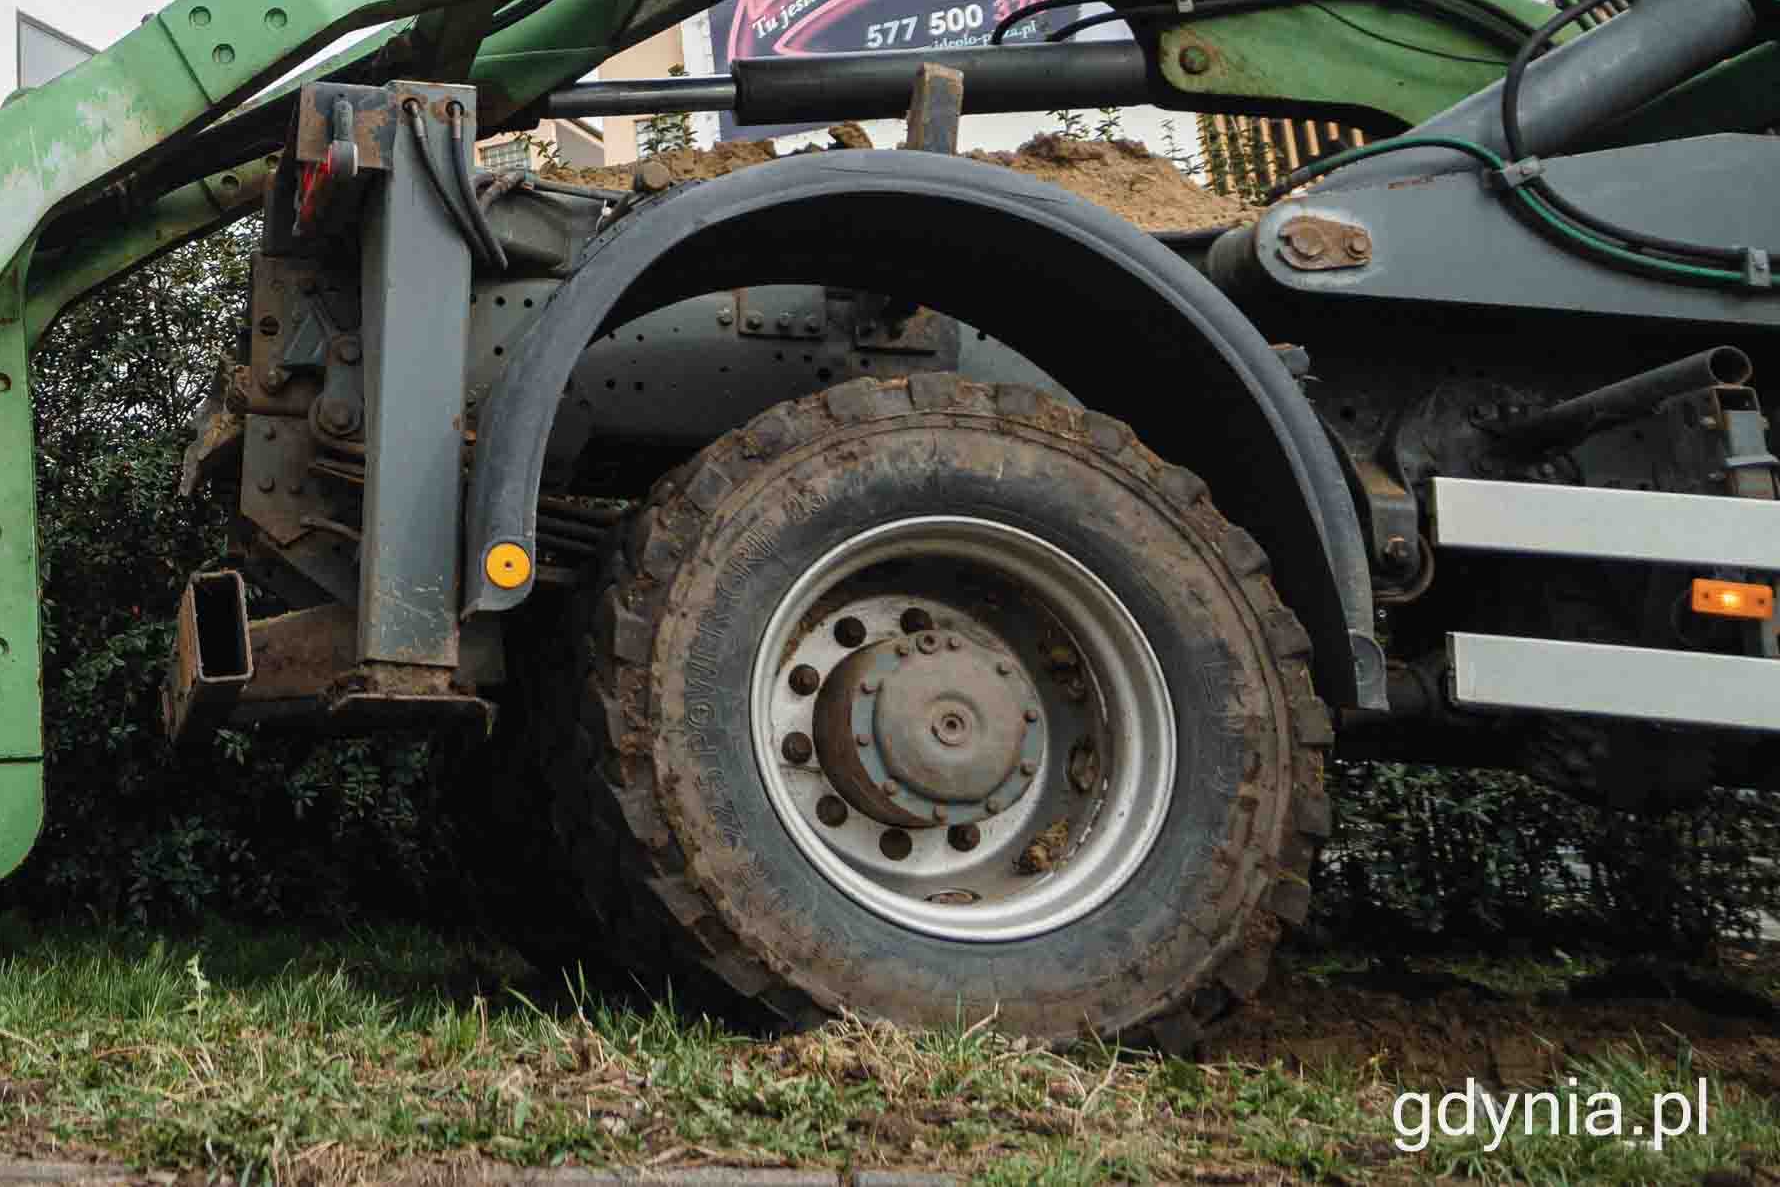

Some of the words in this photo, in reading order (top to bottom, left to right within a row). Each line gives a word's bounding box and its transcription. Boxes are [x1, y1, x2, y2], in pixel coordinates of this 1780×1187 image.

[751, 14, 778, 39] Tu
[867, 17, 919, 48] 577
[929, 4, 984, 36] 500
